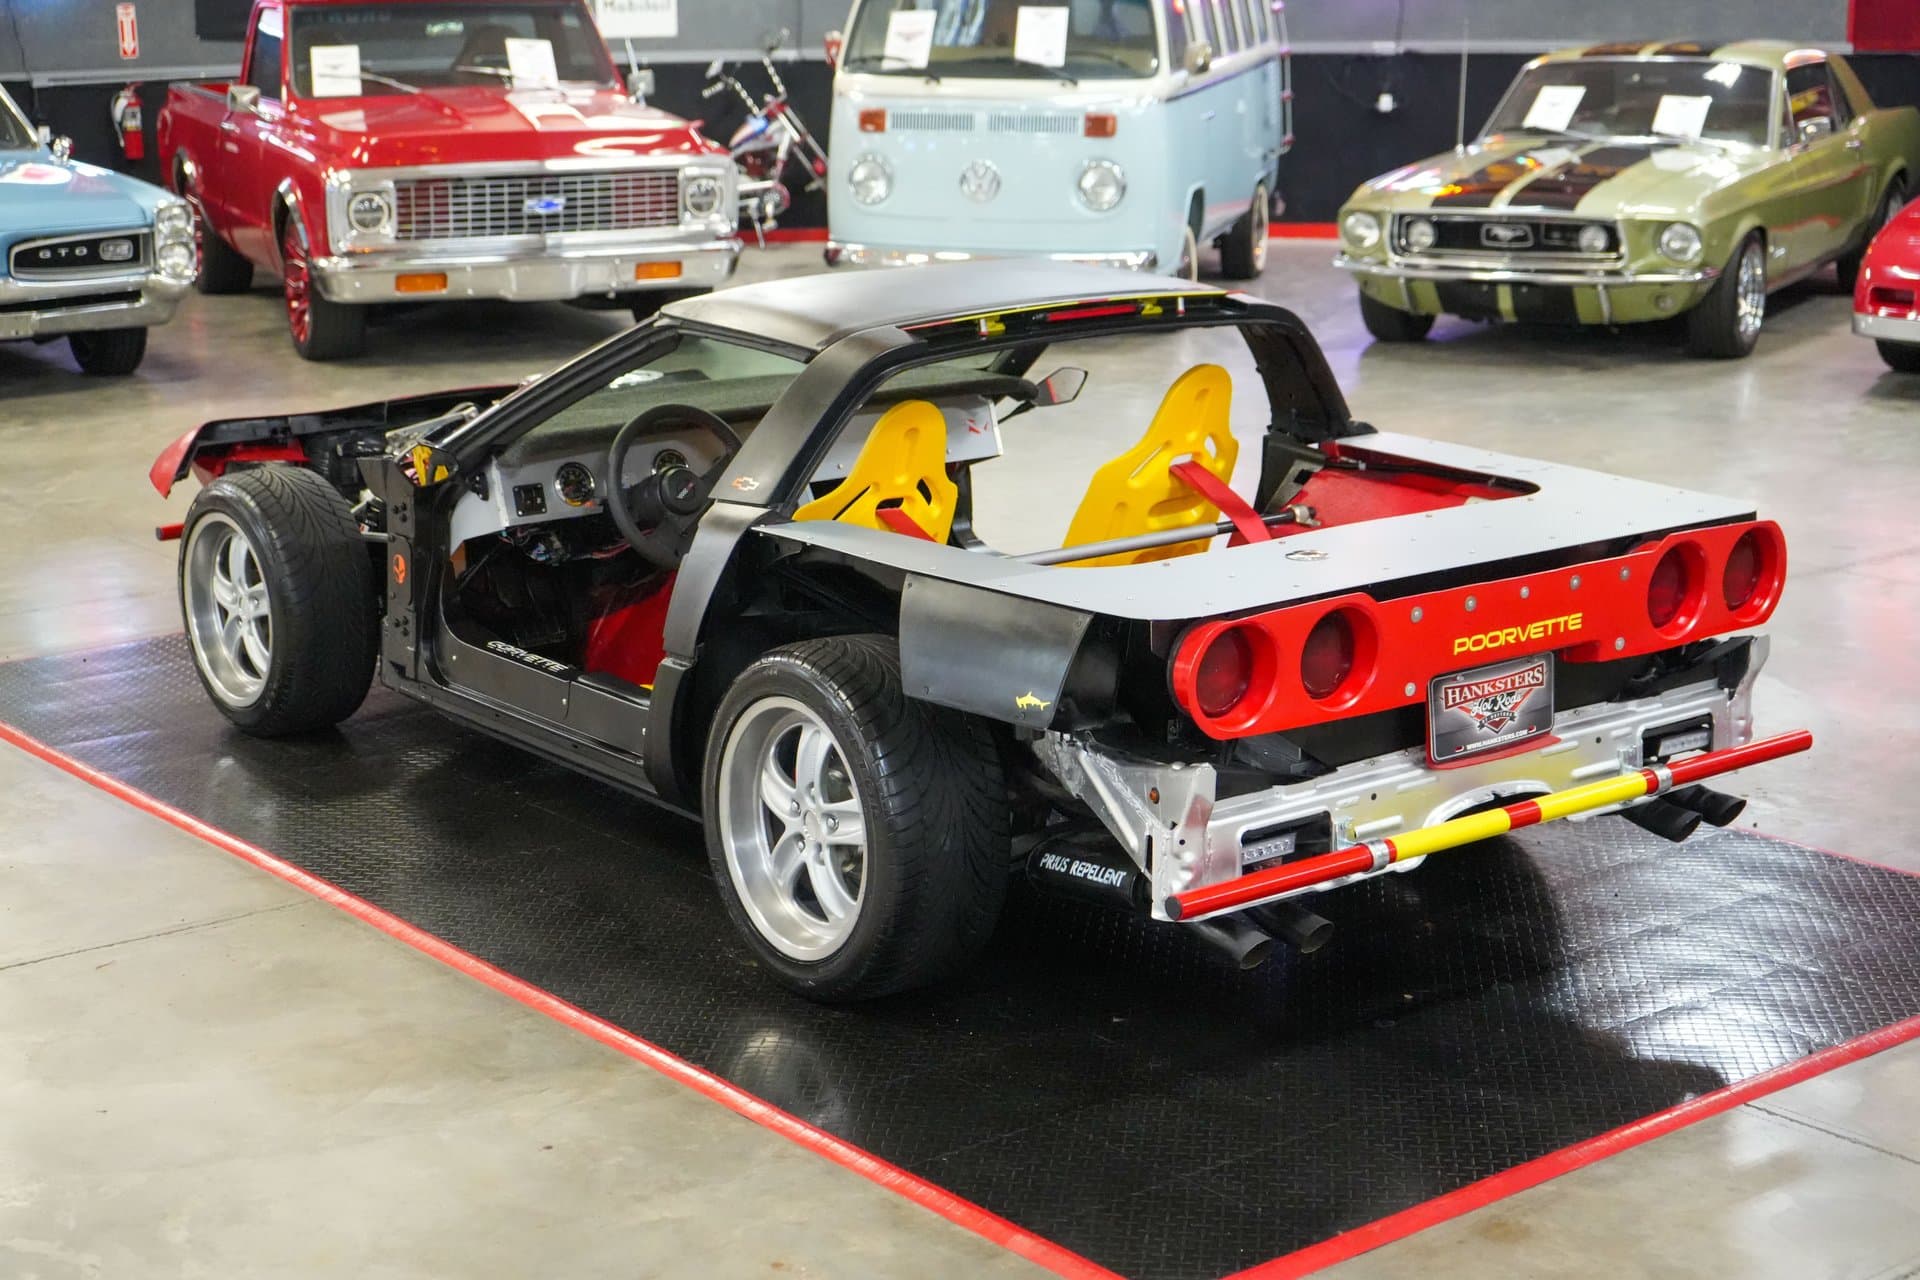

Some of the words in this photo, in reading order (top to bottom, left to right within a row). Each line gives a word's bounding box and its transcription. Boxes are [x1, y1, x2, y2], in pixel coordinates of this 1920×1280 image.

[39, 246, 87, 259] GTO
[1453, 612, 1583, 655] POORVETTE
[487, 640, 568, 672] CORVETTE
[1445, 666, 1543, 707] HANKSTERS
[1471, 697, 1494, 716] Hot
[1494, 691, 1521, 712] Rods
[1040, 853, 1070, 873] PRIUS
[1069, 860, 1127, 888] REPELLENT
